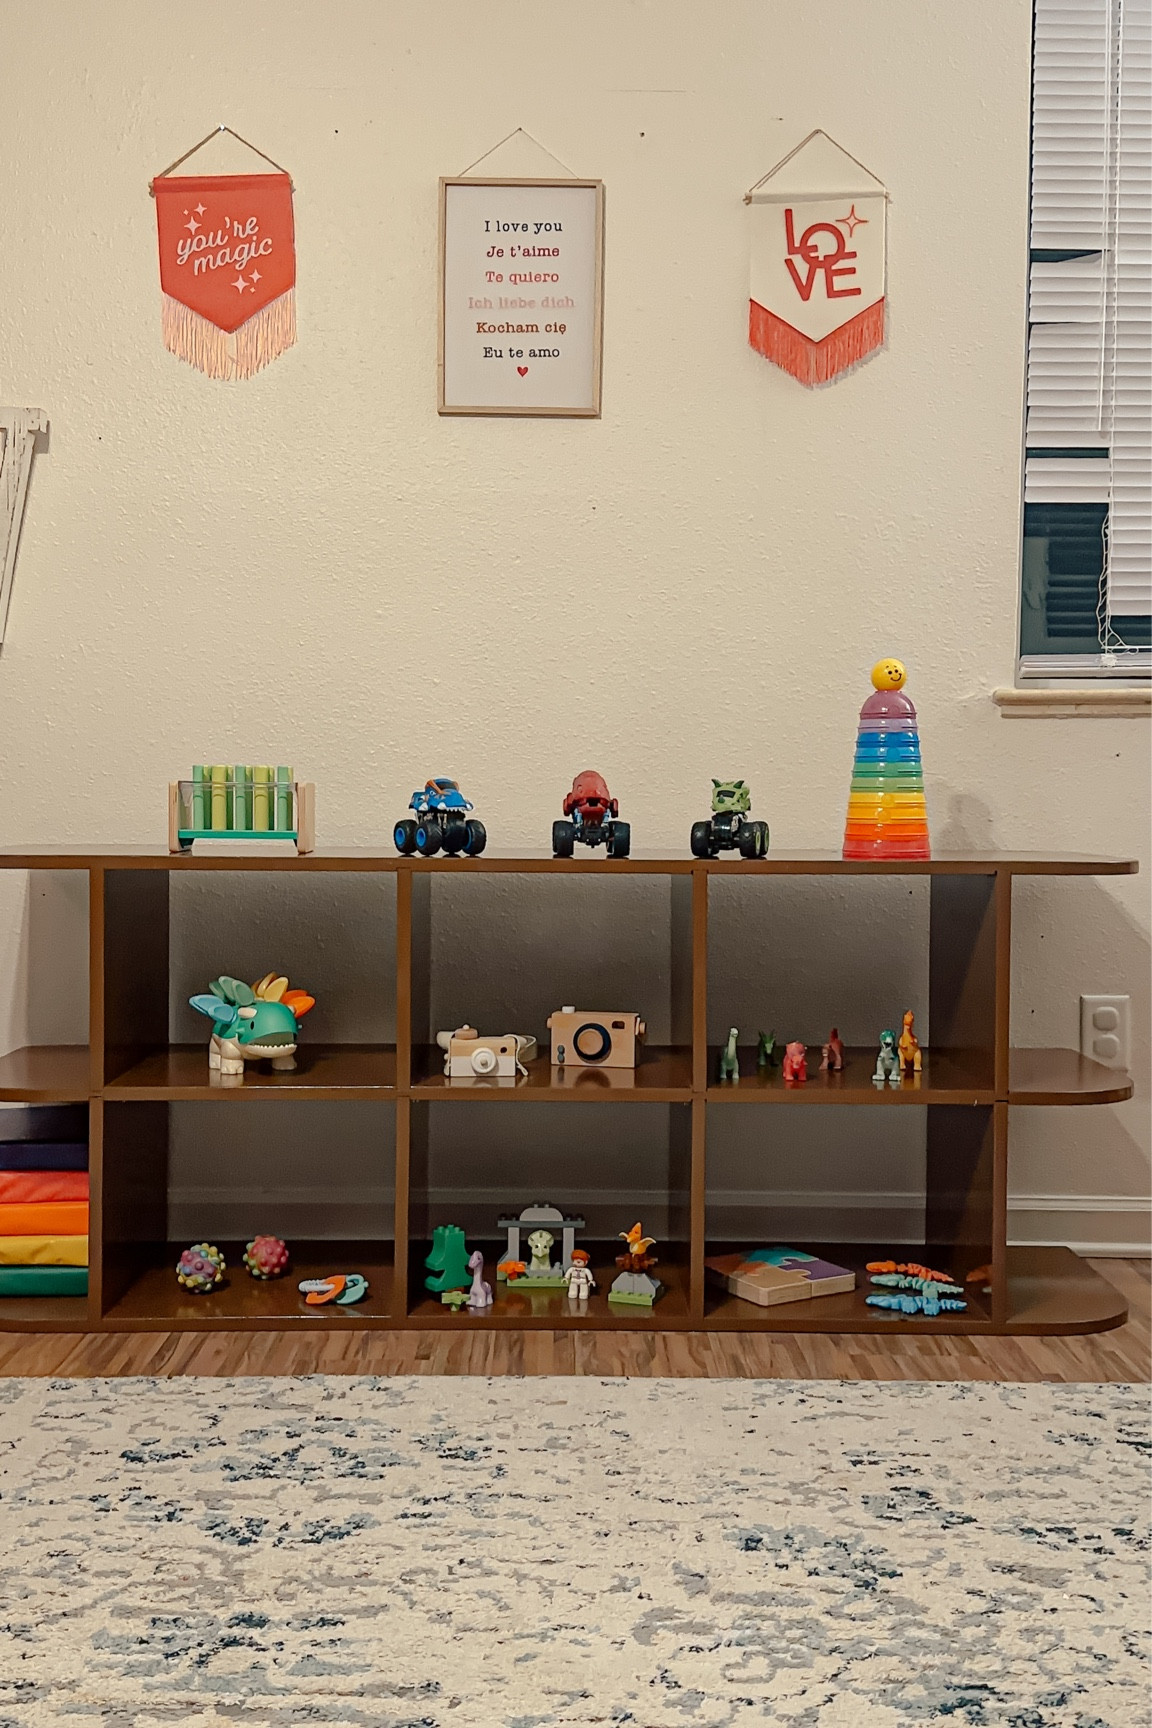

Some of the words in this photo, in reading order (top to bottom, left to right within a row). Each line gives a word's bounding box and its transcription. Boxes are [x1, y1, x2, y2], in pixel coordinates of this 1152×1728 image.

[484, 220, 490, 232] I
[496, 220, 528, 232] love
[534, 222, 563, 234] you
[176, 216, 259, 265] you're
[194, 236, 272, 276] magic
[486, 246, 504, 258] Je
[510, 245, 560, 257] t'aime
[486, 271, 504, 282] Te
[509, 272, 559, 285] quiero
[468, 297, 492, 308] Ich
[500, 297, 536, 309] liebe
[541, 296, 575, 308] dich
[476, 322, 539, 333] Kocham
[544, 322, 566, 334] cię
[483, 347, 503, 358] Eu
[508, 348, 524, 358] te
[528, 348, 560, 358] amo
